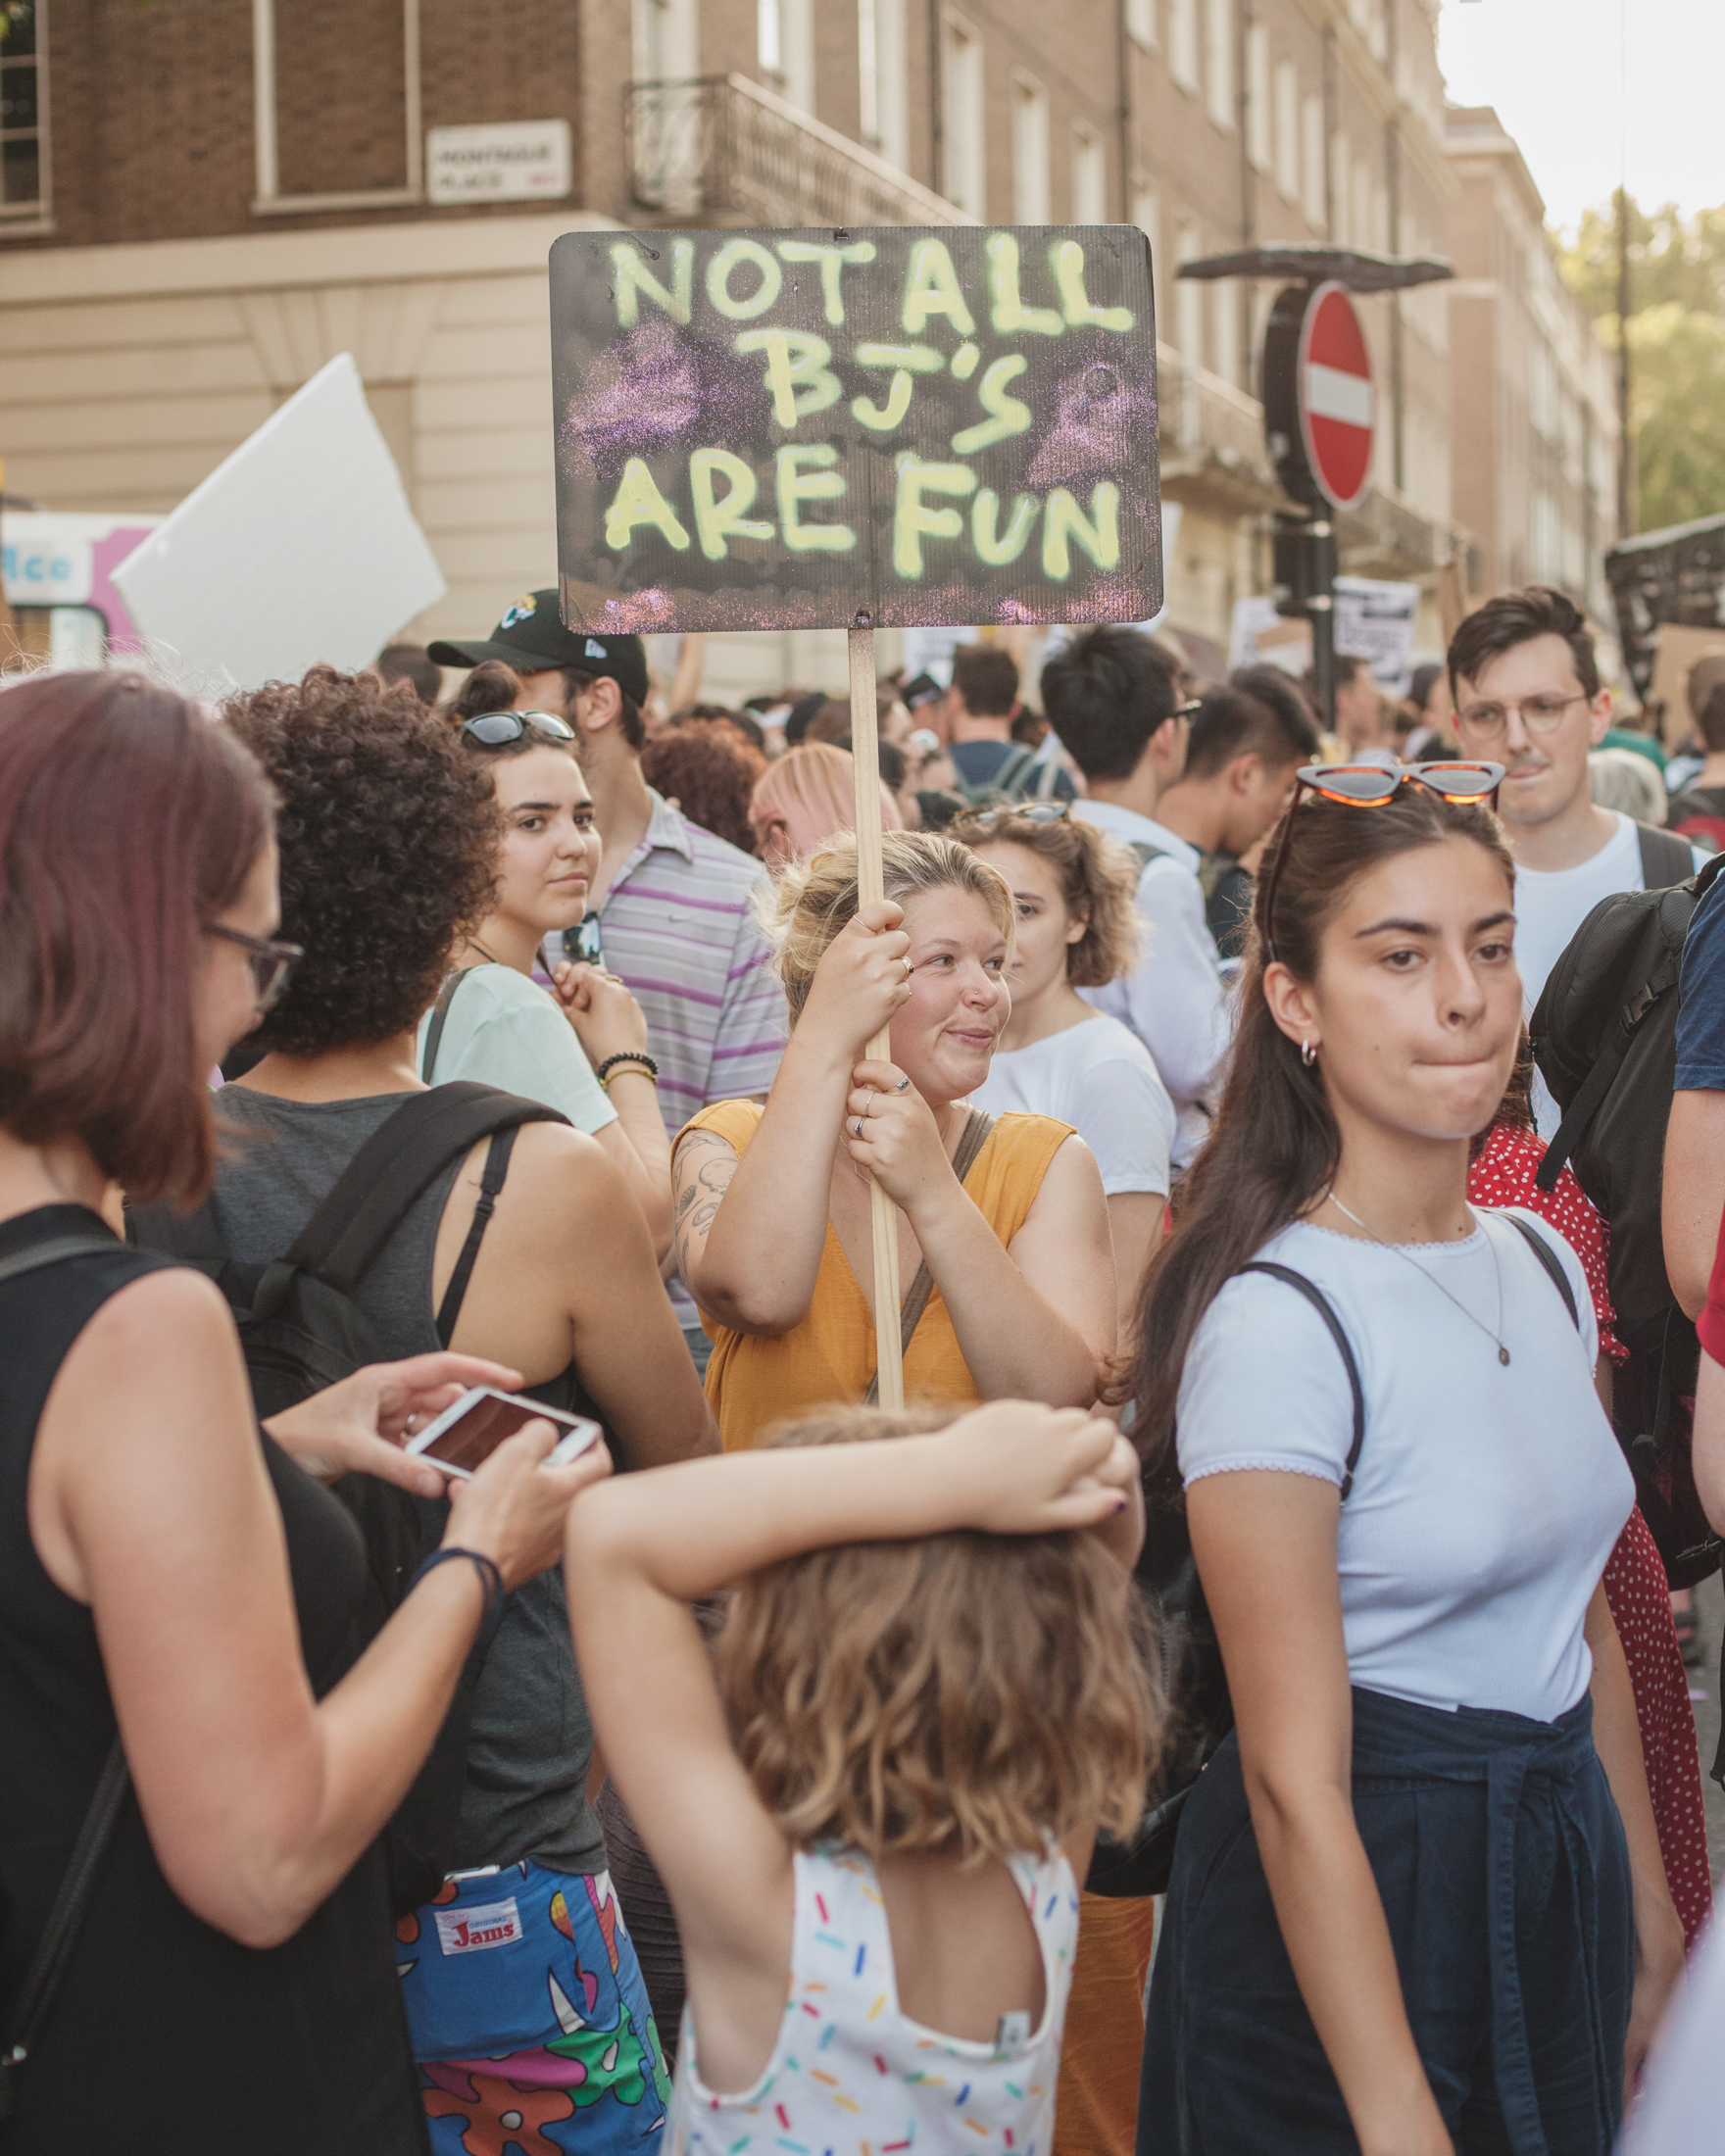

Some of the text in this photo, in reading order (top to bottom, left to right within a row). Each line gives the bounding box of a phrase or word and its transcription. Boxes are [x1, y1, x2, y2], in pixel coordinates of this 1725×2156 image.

[611, 232, 1137, 336] NOT ALL
[735, 328, 1033, 455] BJ'S
[605, 446, 1122, 580] ARE FUN
[452, 1920, 515, 1947] Jams
